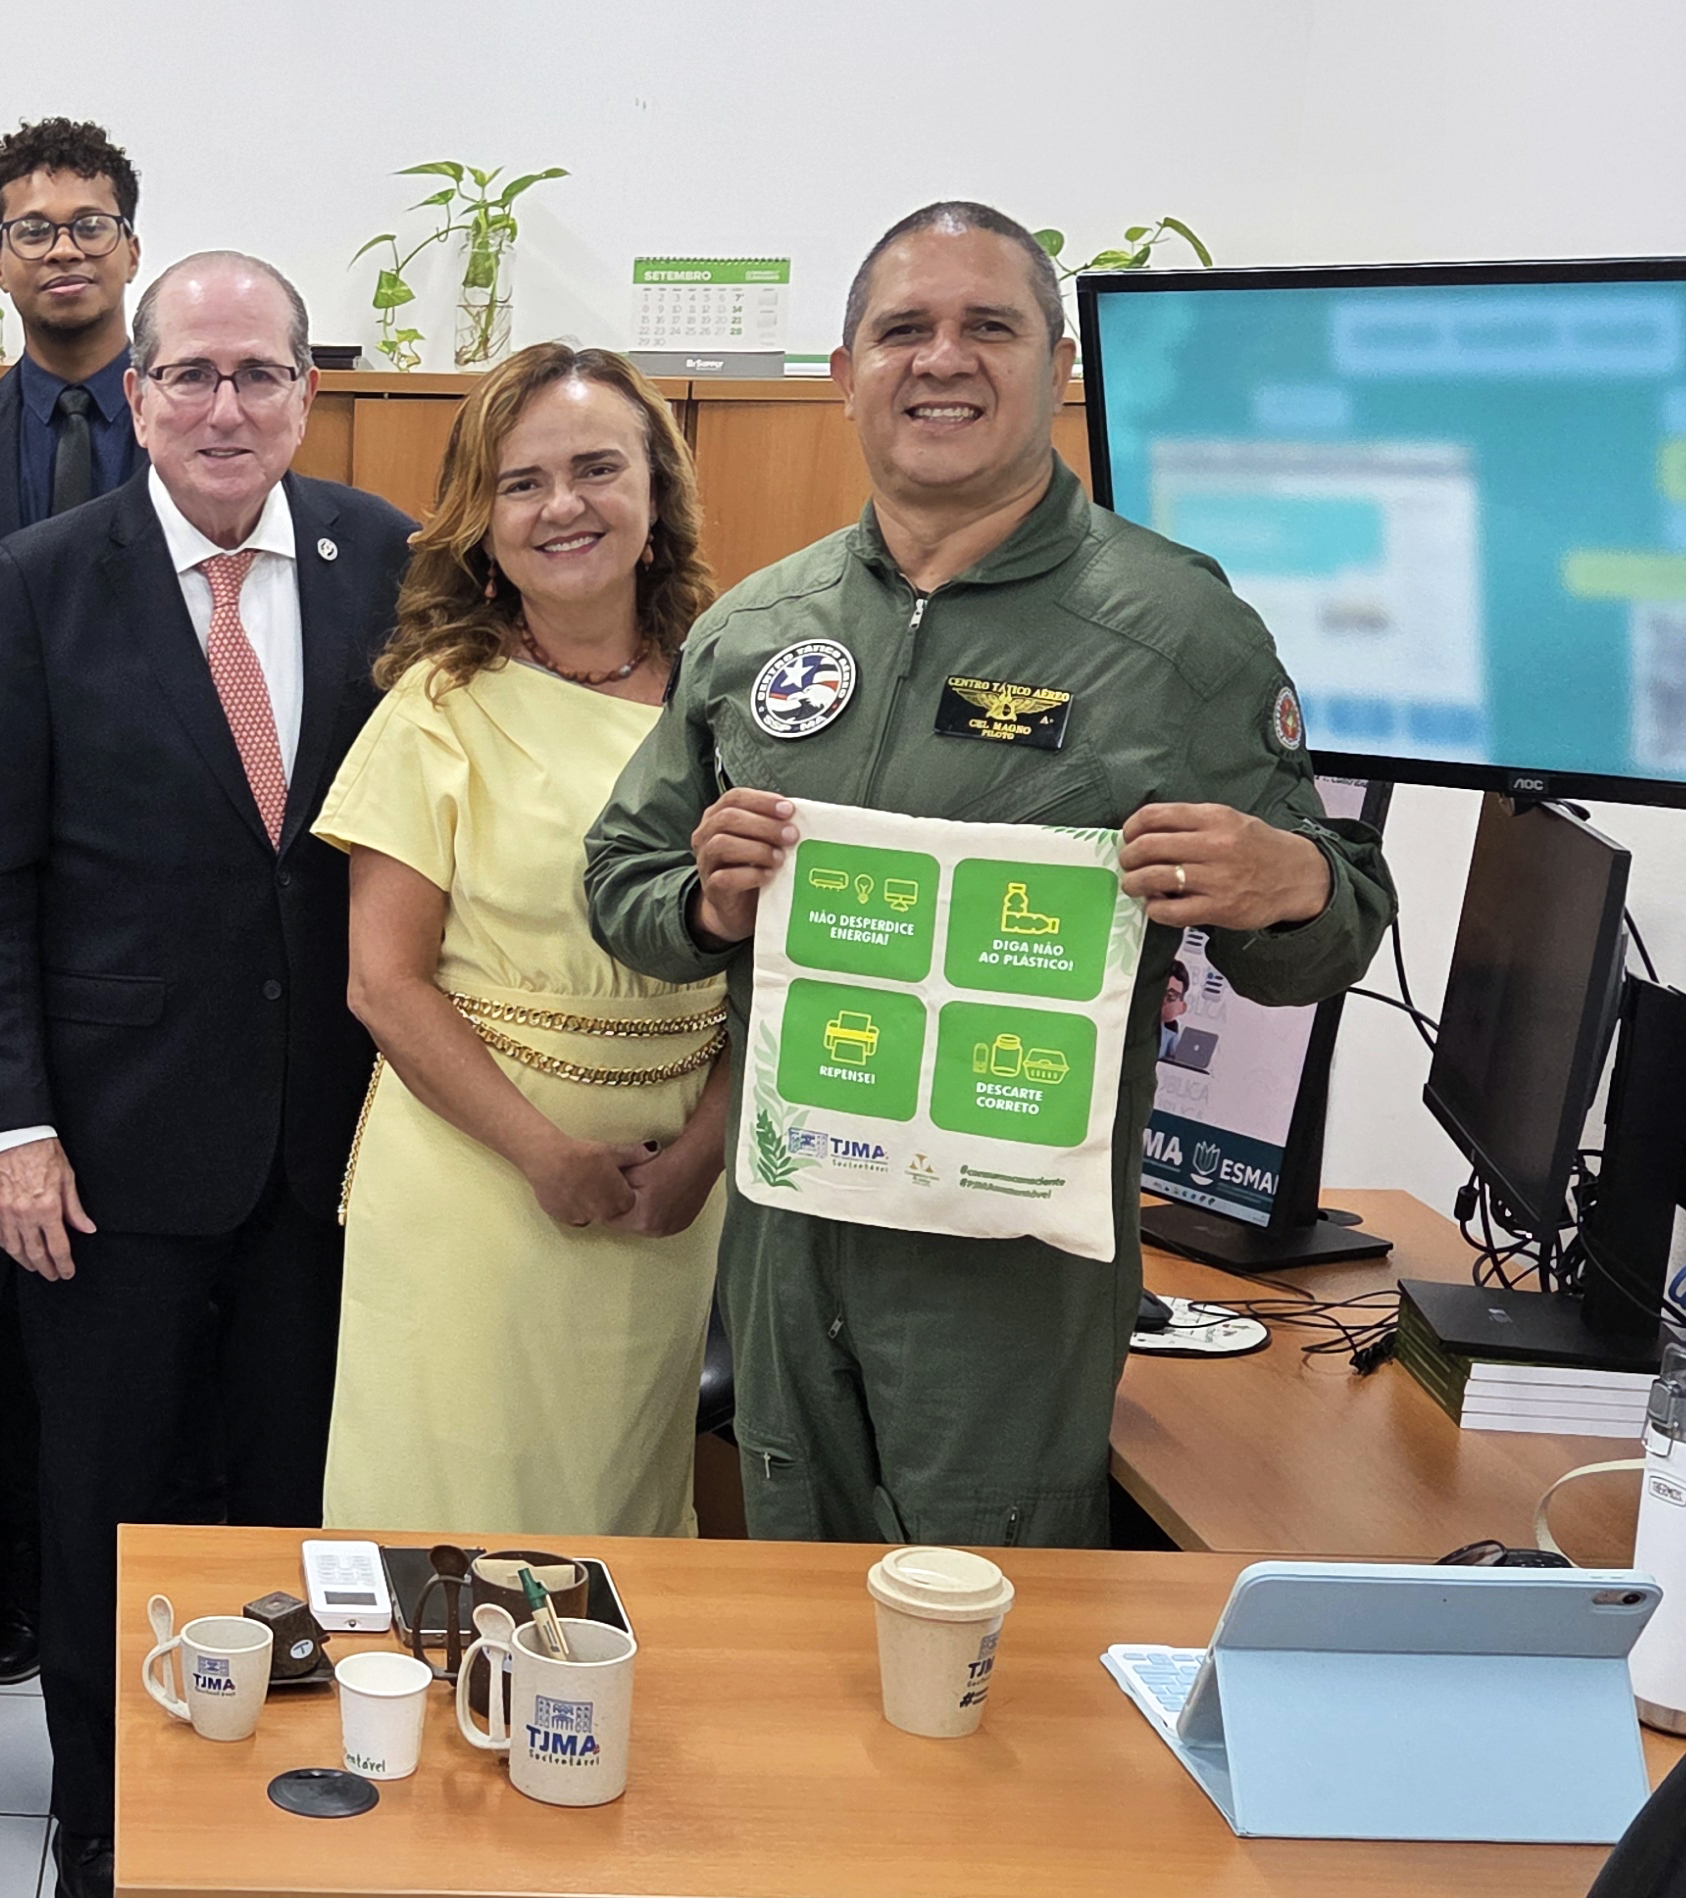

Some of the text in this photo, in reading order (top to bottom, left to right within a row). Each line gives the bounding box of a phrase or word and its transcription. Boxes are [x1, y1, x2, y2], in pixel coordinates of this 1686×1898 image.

[644, 270, 712, 281] SETEMBRO
[948, 677, 1071, 702] CENTRO TÁTICO AÉREO
[981, 729, 1015, 740] PILOTO
[993, 722, 1032, 735] MAGNO
[1513, 778, 1544, 791] AOC
[809, 910, 915, 936] NÃO DESPERDICE
[830, 926, 890, 946] ENERGIA!
[992, 939, 1065, 956] DIGA NÃO
[978, 952, 1074, 972] AO PLÁSTICO!
[819, 1065, 876, 1085] REPENSE!
[976, 1081, 1043, 1102] DESCARTE
[976, 1096, 1040, 1115] CORRETO
[830, 1137, 886, 1160] TJMA
[192, 1672, 236, 1691] TJMA
[526, 1724, 597, 1757] TJMA
